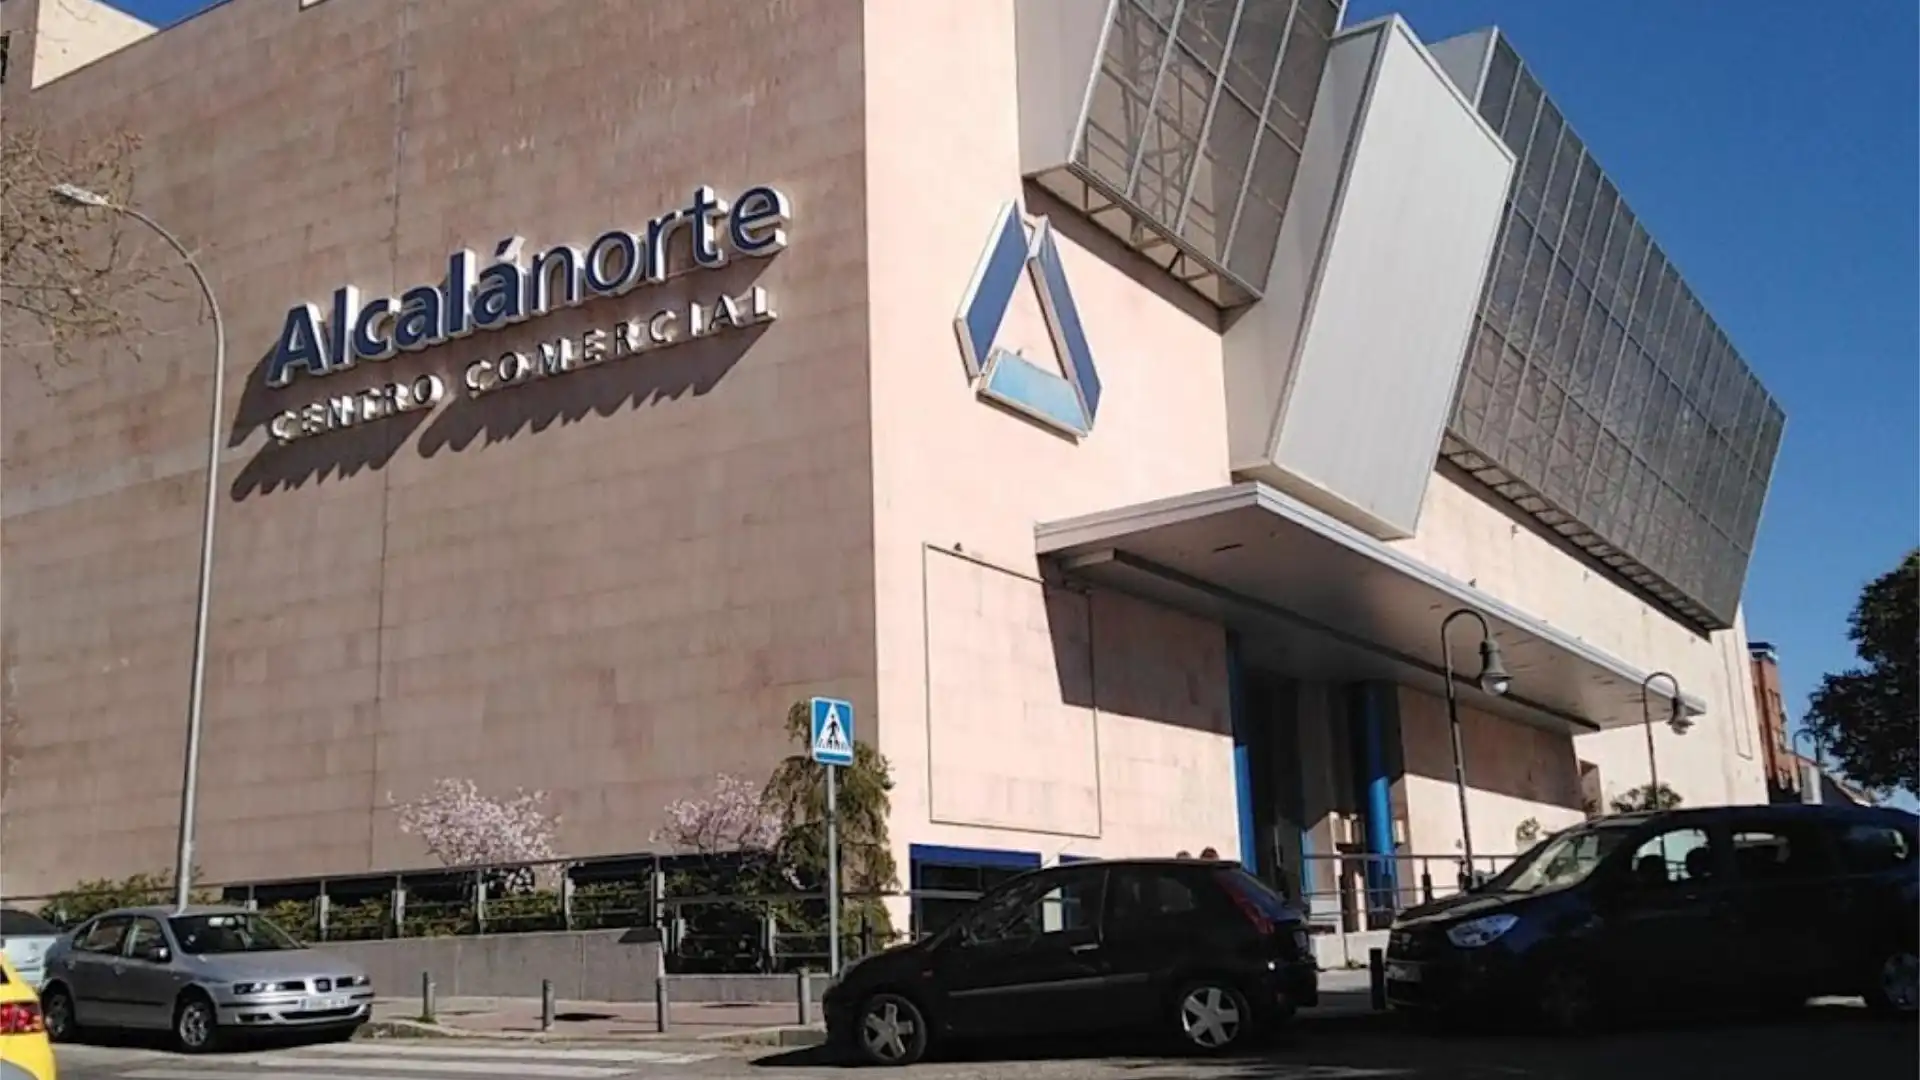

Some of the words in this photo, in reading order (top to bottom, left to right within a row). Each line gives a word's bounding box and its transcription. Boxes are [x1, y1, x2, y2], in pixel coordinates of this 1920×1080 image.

[266, 184, 790, 388] Alcalánorte
[271, 374, 444, 444] CENTRO
[465, 286, 777, 397] COMERCIAL
